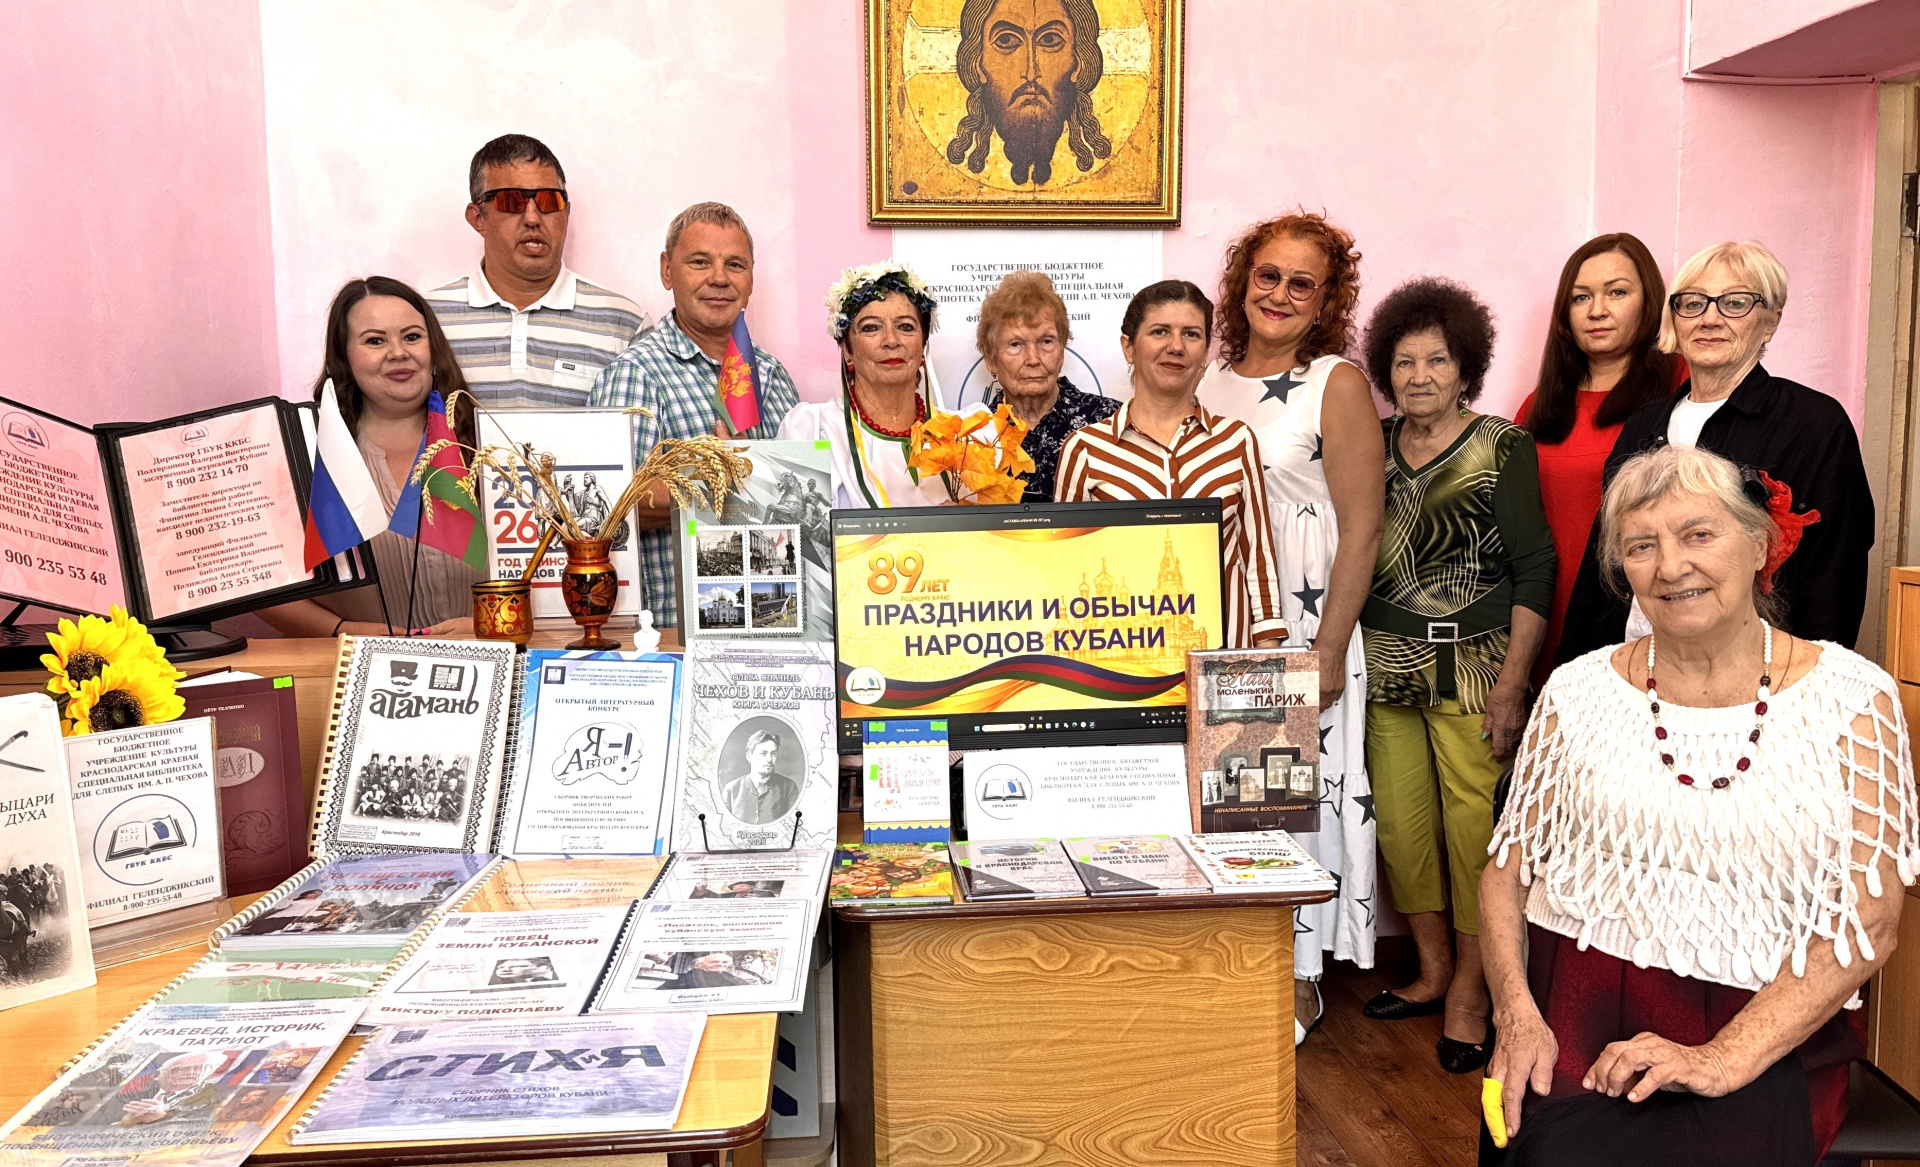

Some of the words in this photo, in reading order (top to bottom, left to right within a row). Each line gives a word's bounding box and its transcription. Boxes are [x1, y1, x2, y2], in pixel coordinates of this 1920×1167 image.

[951, 263, 1042, 272] ГОСУДАРСТВЕННОЕ
[1044, 262, 1104, 271] БЮДЖЕТНОЕ
[932, 284, 999, 293] КРАСНОДАРСК
[1055, 282, 1124, 291] СПЕЦИАЛЬНАЯ
[936, 294, 981, 303] ЛИОТЕКА
[1082, 293, 1099, 301] А.П.
[153, 449, 195, 465] Директор
[197, 443, 223, 456] ГБУК
[225, 437, 252, 449] ККБС
[191, 453, 223, 466] Валерия
[225, 442, 270, 457] Викторовна
[0, 449, 79, 480] СУДАРСТВЕННОЕ
[4, 460, 66, 485] БЮДЖЕТНОЕ
[142, 467, 195, 484] заслуженный
[196, 458, 238, 472] журналист
[239, 451, 268, 463] Кубани
[167, 481, 174, 489] 8
[176, 476, 196, 488] 900
[199, 470, 218, 482] 232
[221, 467, 234, 477] 14
[235, 463, 249, 473] 70
[4, 487, 75, 513] СПЕЦИАЛЬНАЯ
[44, 482, 94, 501] КУЛЬТУРЫ
[160, 493, 210, 508] Заместитель
[211, 484, 251, 498] директора
[172, 495, 227, 514] библиотечной
[228, 489, 254, 502] работе
[492, 475, 536, 509] 20
[57, 494, 100, 511] КРАЕВАЯ
[200, 503, 227, 516] Лилия
[32, 513, 51, 524] А.П.
[52, 518, 90, 535] ЧЕХОВА
[43, 507, 62, 518] ДЛЯ
[64, 513, 104, 529] СЛЕПЫХ
[156, 520, 194, 534] кандидат
[195, 506, 255, 525] педагогических
[256, 500, 276, 512] наук
[175, 531, 183, 540] 8
[185, 526, 205, 538] 900
[207, 512, 261, 532] 232-19-63
[494, 510, 538, 544] 26
[24, 529, 109, 557] ГЕЛЕНДЖИКСКИЙ
[176, 541, 225, 558] заведующий
[226, 530, 267, 545] Филиалом
[192, 541, 255, 562] Геленджикский
[5, 549, 32, 567] 900
[37, 557, 64, 575] 235
[69, 565, 86, 580] 53
[90, 571, 107, 586] 48
[165, 564, 195, 577] Попова
[196, 554, 239, 570] Екатерина
[240, 543, 284, 558] Вадимовна
[199, 559, 254, 577] библиотекарь
[219, 569, 241, 580] Анна
[242, 559, 283, 574] Сергеевна
[498, 558, 522, 567] ГОД
[499, 569, 556, 579] НАРДОВ
[867, 550, 924, 595] 89
[920, 579, 950, 593] ЛЕТ
[187, 590, 195, 599] 8
[197, 584, 218, 597] 900
[219, 580, 234, 591] 23
[236, 575, 250, 587] 55
[251, 570, 272, 583] 348
[863, 599, 1033, 627] ПРАЗДНИКИ
[1043, 598, 1061, 620] И
[1069, 594, 1196, 619] ОБЫЧАИ
[904, 630, 1045, 658] НАРОДОВ
[1053, 626, 1166, 653] КУБАНИ
[694, 684, 749, 699] ЧЕХОВ
[753, 685, 766, 699] И
[769, 686, 835, 700] КУБАНЬ
[1217, 686, 1274, 696] маленький
[1255, 693, 1306, 707] ПАРИЖ
[732, 700, 760, 709] КНИГА
[761, 701, 800, 710] ОЧЕРКОВ
[98, 727, 184, 746] ГОСУДАРСТВЕННОЕ
[113, 738, 171, 753] БЮДЖЕТНОЕ
[582, 727, 606, 758] Я
[80, 760, 157, 778] КРАСНОДАРСКАЯ
[160, 753, 199, 766] КРАЕВАЯ
[86, 751, 147, 768] УЧРЕЖДЕНИЕ
[150, 744, 197, 757] КУЛЬТУРЫ
[72, 789, 91, 800] ДЛЯ
[95, 783, 134, 796] СЛЕПЫХ
[137, 780, 154, 789] ИМ.
[155, 778, 164, 786] А.
[165, 776, 174, 784] П.
[175, 771, 208, 783] ЧЕХОВА
[77, 771, 145, 789] СПЕЦИАЛЬНАЯ
[146, 763, 203, 778] БИБЛИОТЕКА
[0, 793, 54, 813] ЫЦАРИ
[5, 808, 47, 828] ДУХА
[125, 860, 147, 869] ГБУК
[150, 855, 173, 865] ККБС
[323, 870, 455, 880] ПУТЕШЕСТВУЙ
[87, 894, 129, 910] ФИЛИАЛ
[132, 874, 215, 900] ГЕЛЕНДЖИКСКИЙ
[331, 882, 421, 891] ПОЛЯНОЙ
[123, 892, 183, 911] 8-900-235-53-48
[493, 934, 550, 942] ПЕВЕЦ
[498, 937, 599, 948] КУБАНСКОЙ
[380, 1006, 454, 1015] ВИКТОРУ
[457, 1005, 565, 1015] ПОДКОПАЕВУ
[139, 1026, 229, 1036] КРАЕВЕД,
[236, 1022, 326, 1034] ИСТОРИК,
[179, 1036, 269, 1047] ПАТРИОТ
[388, 1097, 460, 1106] МОЛОДЫХ
[462, 1093, 556, 1103] ЛИТЕРАТОРОВ
[451, 1088, 511, 1096] СБОРНИК
[32, 1130, 173, 1142] БИОГРАФИЧЕСКИЙ
[174, 1128, 222, 1138] ОЧЕРК,
[150, 1135, 239, 1147] СОЛОВЬЁВУ
